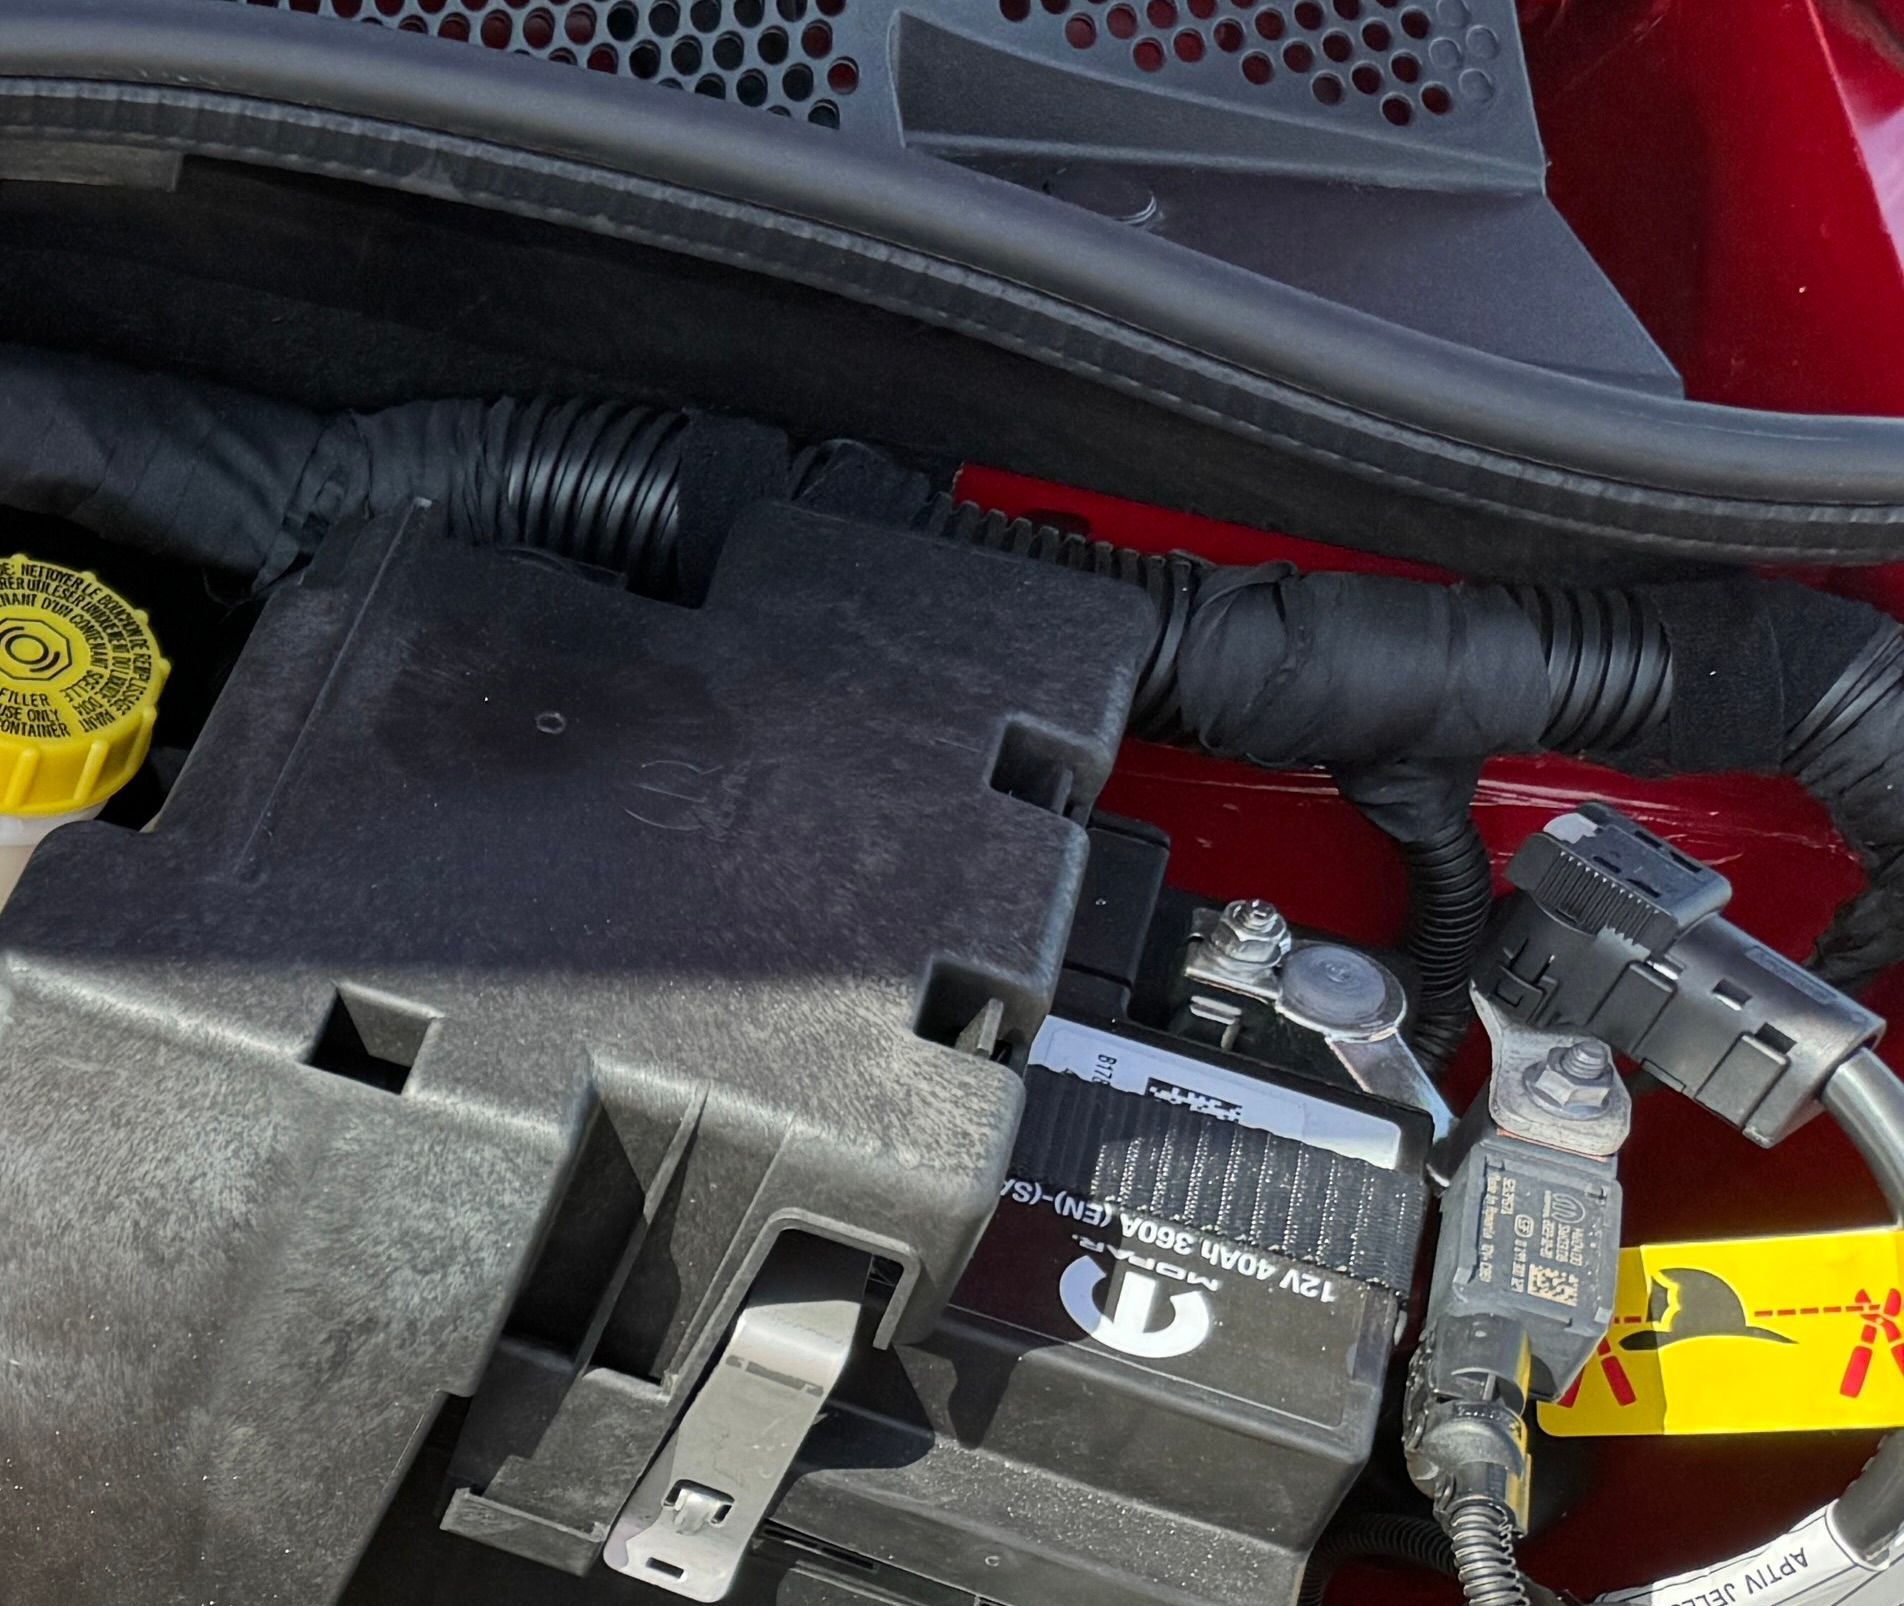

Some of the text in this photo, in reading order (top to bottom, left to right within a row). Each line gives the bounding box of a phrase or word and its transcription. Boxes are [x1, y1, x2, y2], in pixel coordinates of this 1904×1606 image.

[81, 581, 102, 598] LE
[27, 708, 62, 723] ONLY
[1120, 1213, 1196, 1256] 360A
[1199, 1239, 1278, 1281] 40Ah
[1279, 1268, 1337, 1303] 12V
[1745, 1547, 1809, 1594] APTIV
